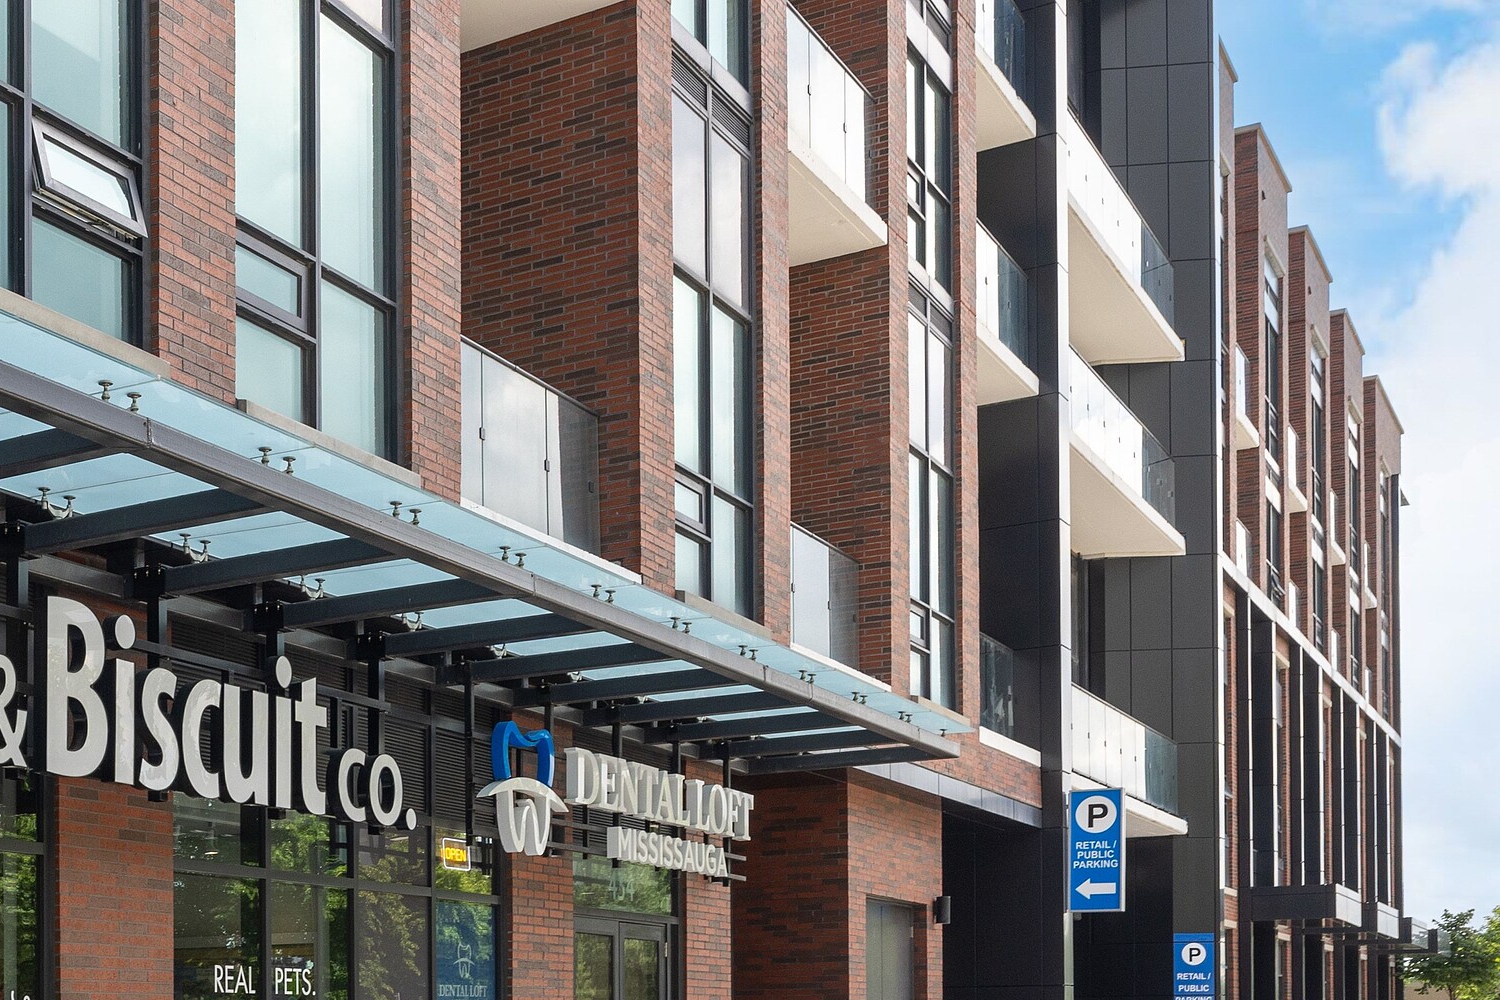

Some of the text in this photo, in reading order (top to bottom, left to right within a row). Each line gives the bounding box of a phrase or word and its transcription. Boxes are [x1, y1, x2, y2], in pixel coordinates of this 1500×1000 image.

[45, 594, 328, 816] Biscuit
[336, 747, 418, 831] co.
[566, 747, 754, 841] DENTAL LOFT
[1088, 804, 1108, 828] P
[612, 826, 729, 877] MISSISSAUGA
[1075, 840, 1110, 850] RETAIL
[445, 847, 467, 862] OPEN
[1077, 850, 1114, 859] PUBLIC
[1073, 860, 1118, 869] PARKING
[1189, 948, 1200, 962] P
[214, 964, 317, 996] REAL PETS.
[439, 985, 487, 997] DENTAL LOFT
